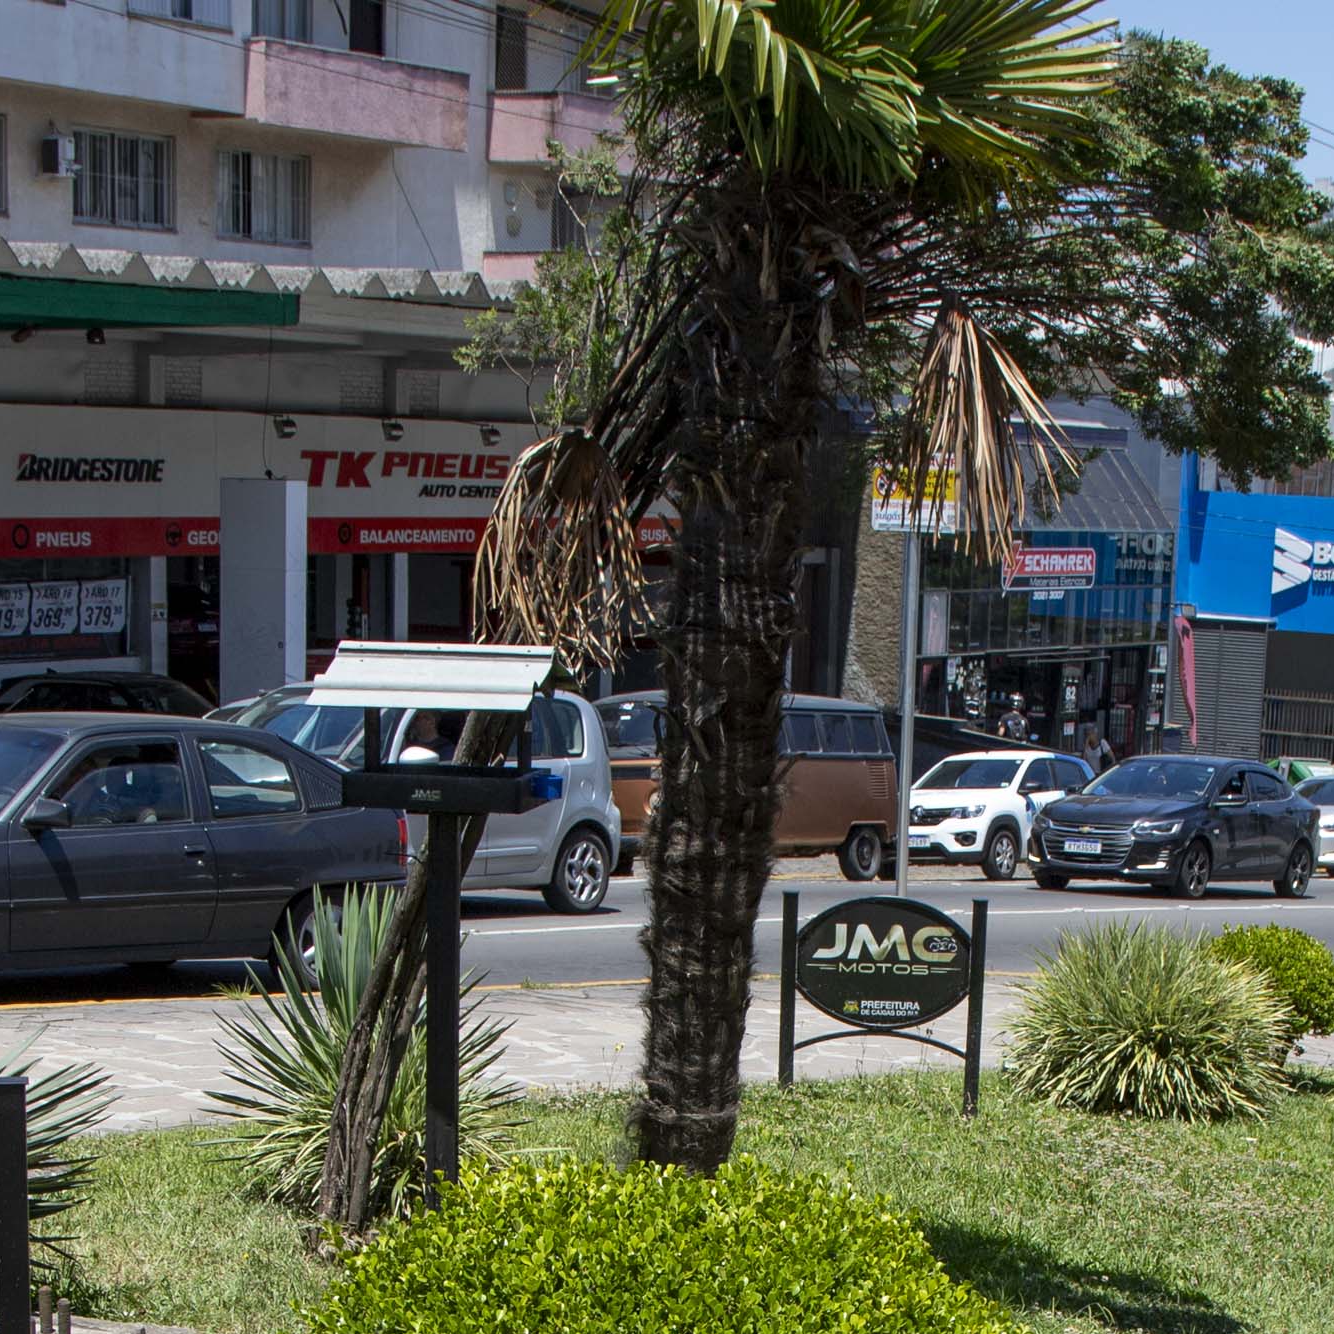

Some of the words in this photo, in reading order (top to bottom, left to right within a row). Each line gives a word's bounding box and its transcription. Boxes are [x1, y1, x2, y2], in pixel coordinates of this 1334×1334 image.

[16, 454, 165, 482] BRIDGESTONE
[300, 450, 376, 488] TK
[381, 452, 511, 479] PNEUS
[419, 484, 456, 497] AUTO
[458, 484, 503, 498] CENTE
[36, 531, 92, 547] PNEUS
[188, 531, 220, 545] GEO
[360, 529, 475, 544] BALANCEAMENTO
[641, 529, 672, 542] SUSP
[812, 923, 958, 963] JMC
[838, 962, 930, 975] MOTOS
[860, 1000, 920, 1010] PREFEITURA
